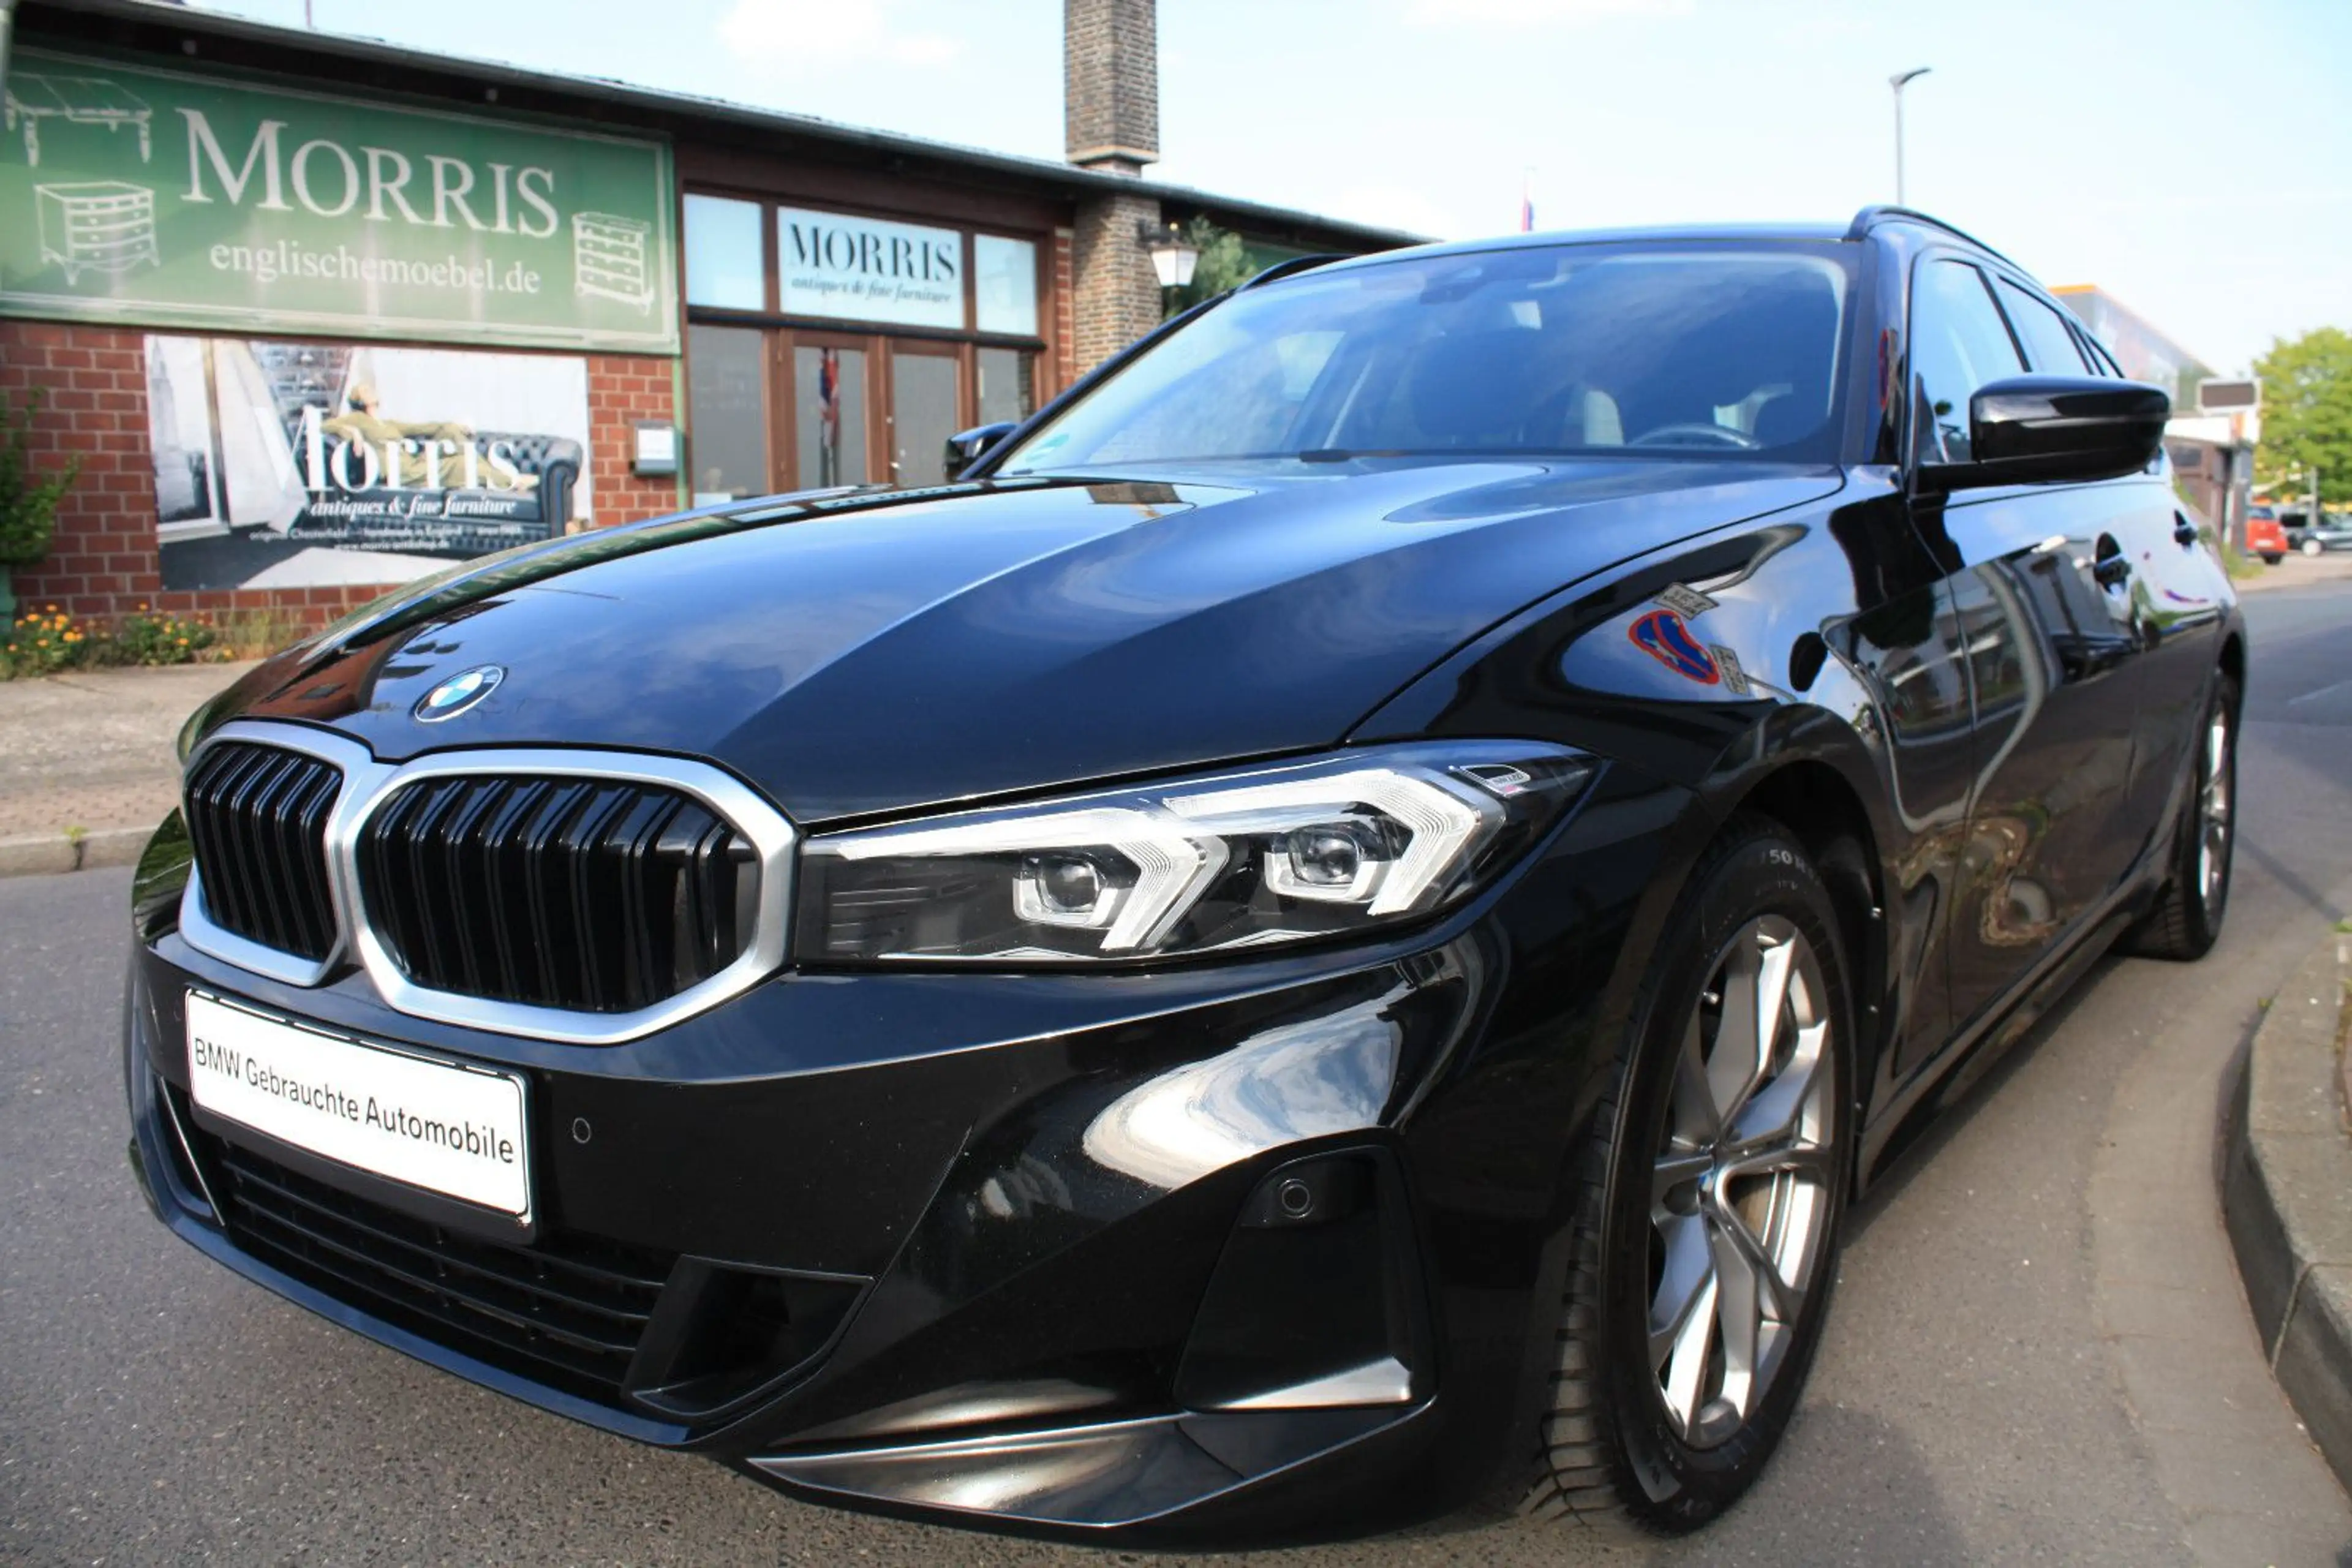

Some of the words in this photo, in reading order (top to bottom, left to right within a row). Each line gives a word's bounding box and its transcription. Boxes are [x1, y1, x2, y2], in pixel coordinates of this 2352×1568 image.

[177, 109, 557, 238] MORRIS
[210, 240, 540, 293] englischemoebel.de
[790, 222, 955, 281] MORRIS
[791, 277, 848, 295] antiques
[852, 279, 864, 295] &
[866, 279, 892, 300] fine
[893, 284, 952, 303] furniture
[310, 496, 385, 521] antiques
[388, 496, 405, 516] &
[404, 494, 442, 521] fine
[439, 493, 517, 520] furniture
[195, 1037, 240, 1080] BMW
[246, 1058, 359, 1122] Gebrauchte
[366, 1095, 514, 1164] Automobile
